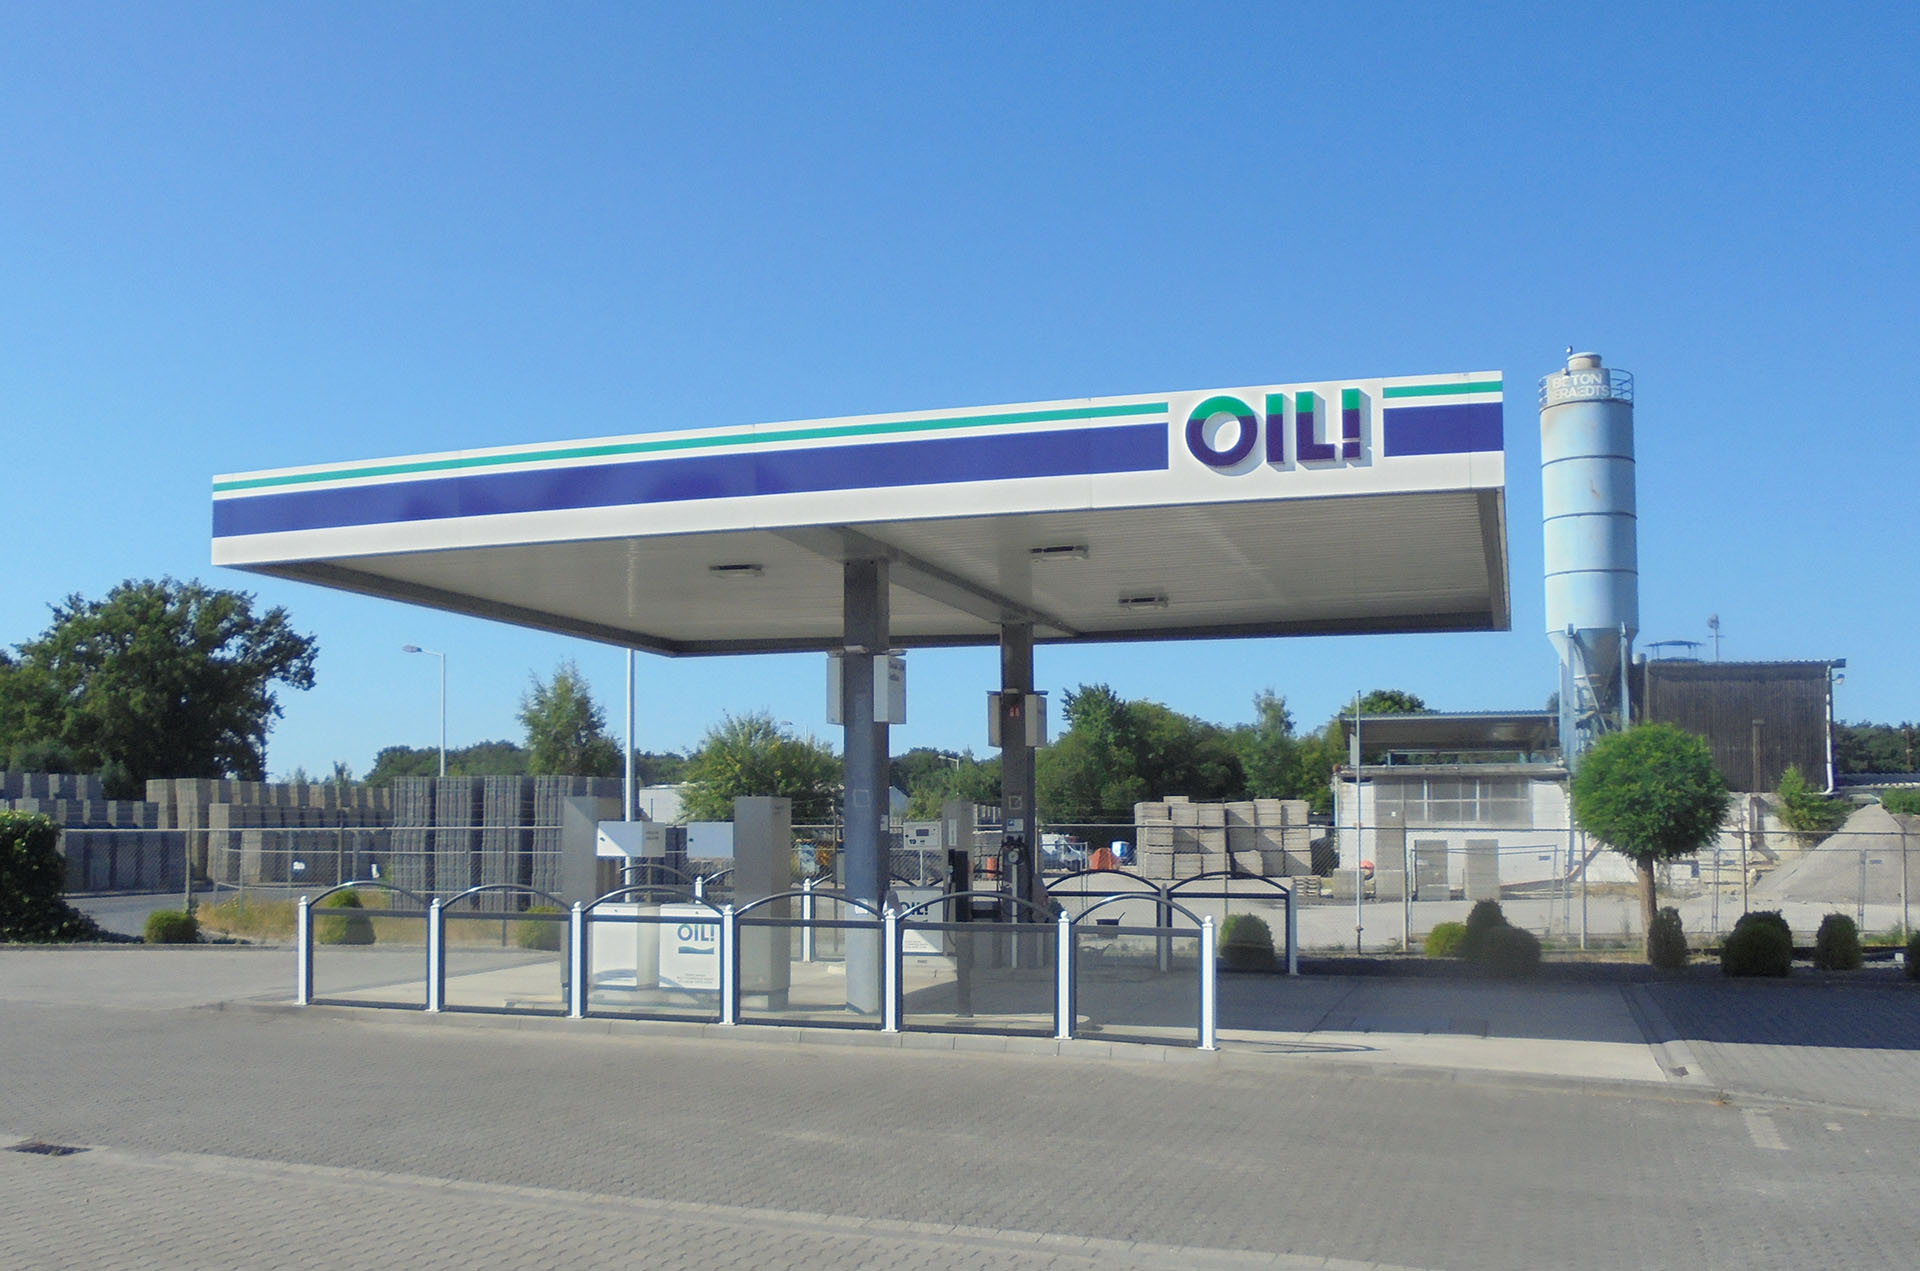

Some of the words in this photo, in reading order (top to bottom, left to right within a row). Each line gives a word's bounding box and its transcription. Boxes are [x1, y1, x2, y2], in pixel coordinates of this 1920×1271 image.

[1552, 373, 1602, 389] BETON
[1185, 388, 1362, 467] OIL!
[677, 924, 714, 941] OIL!
